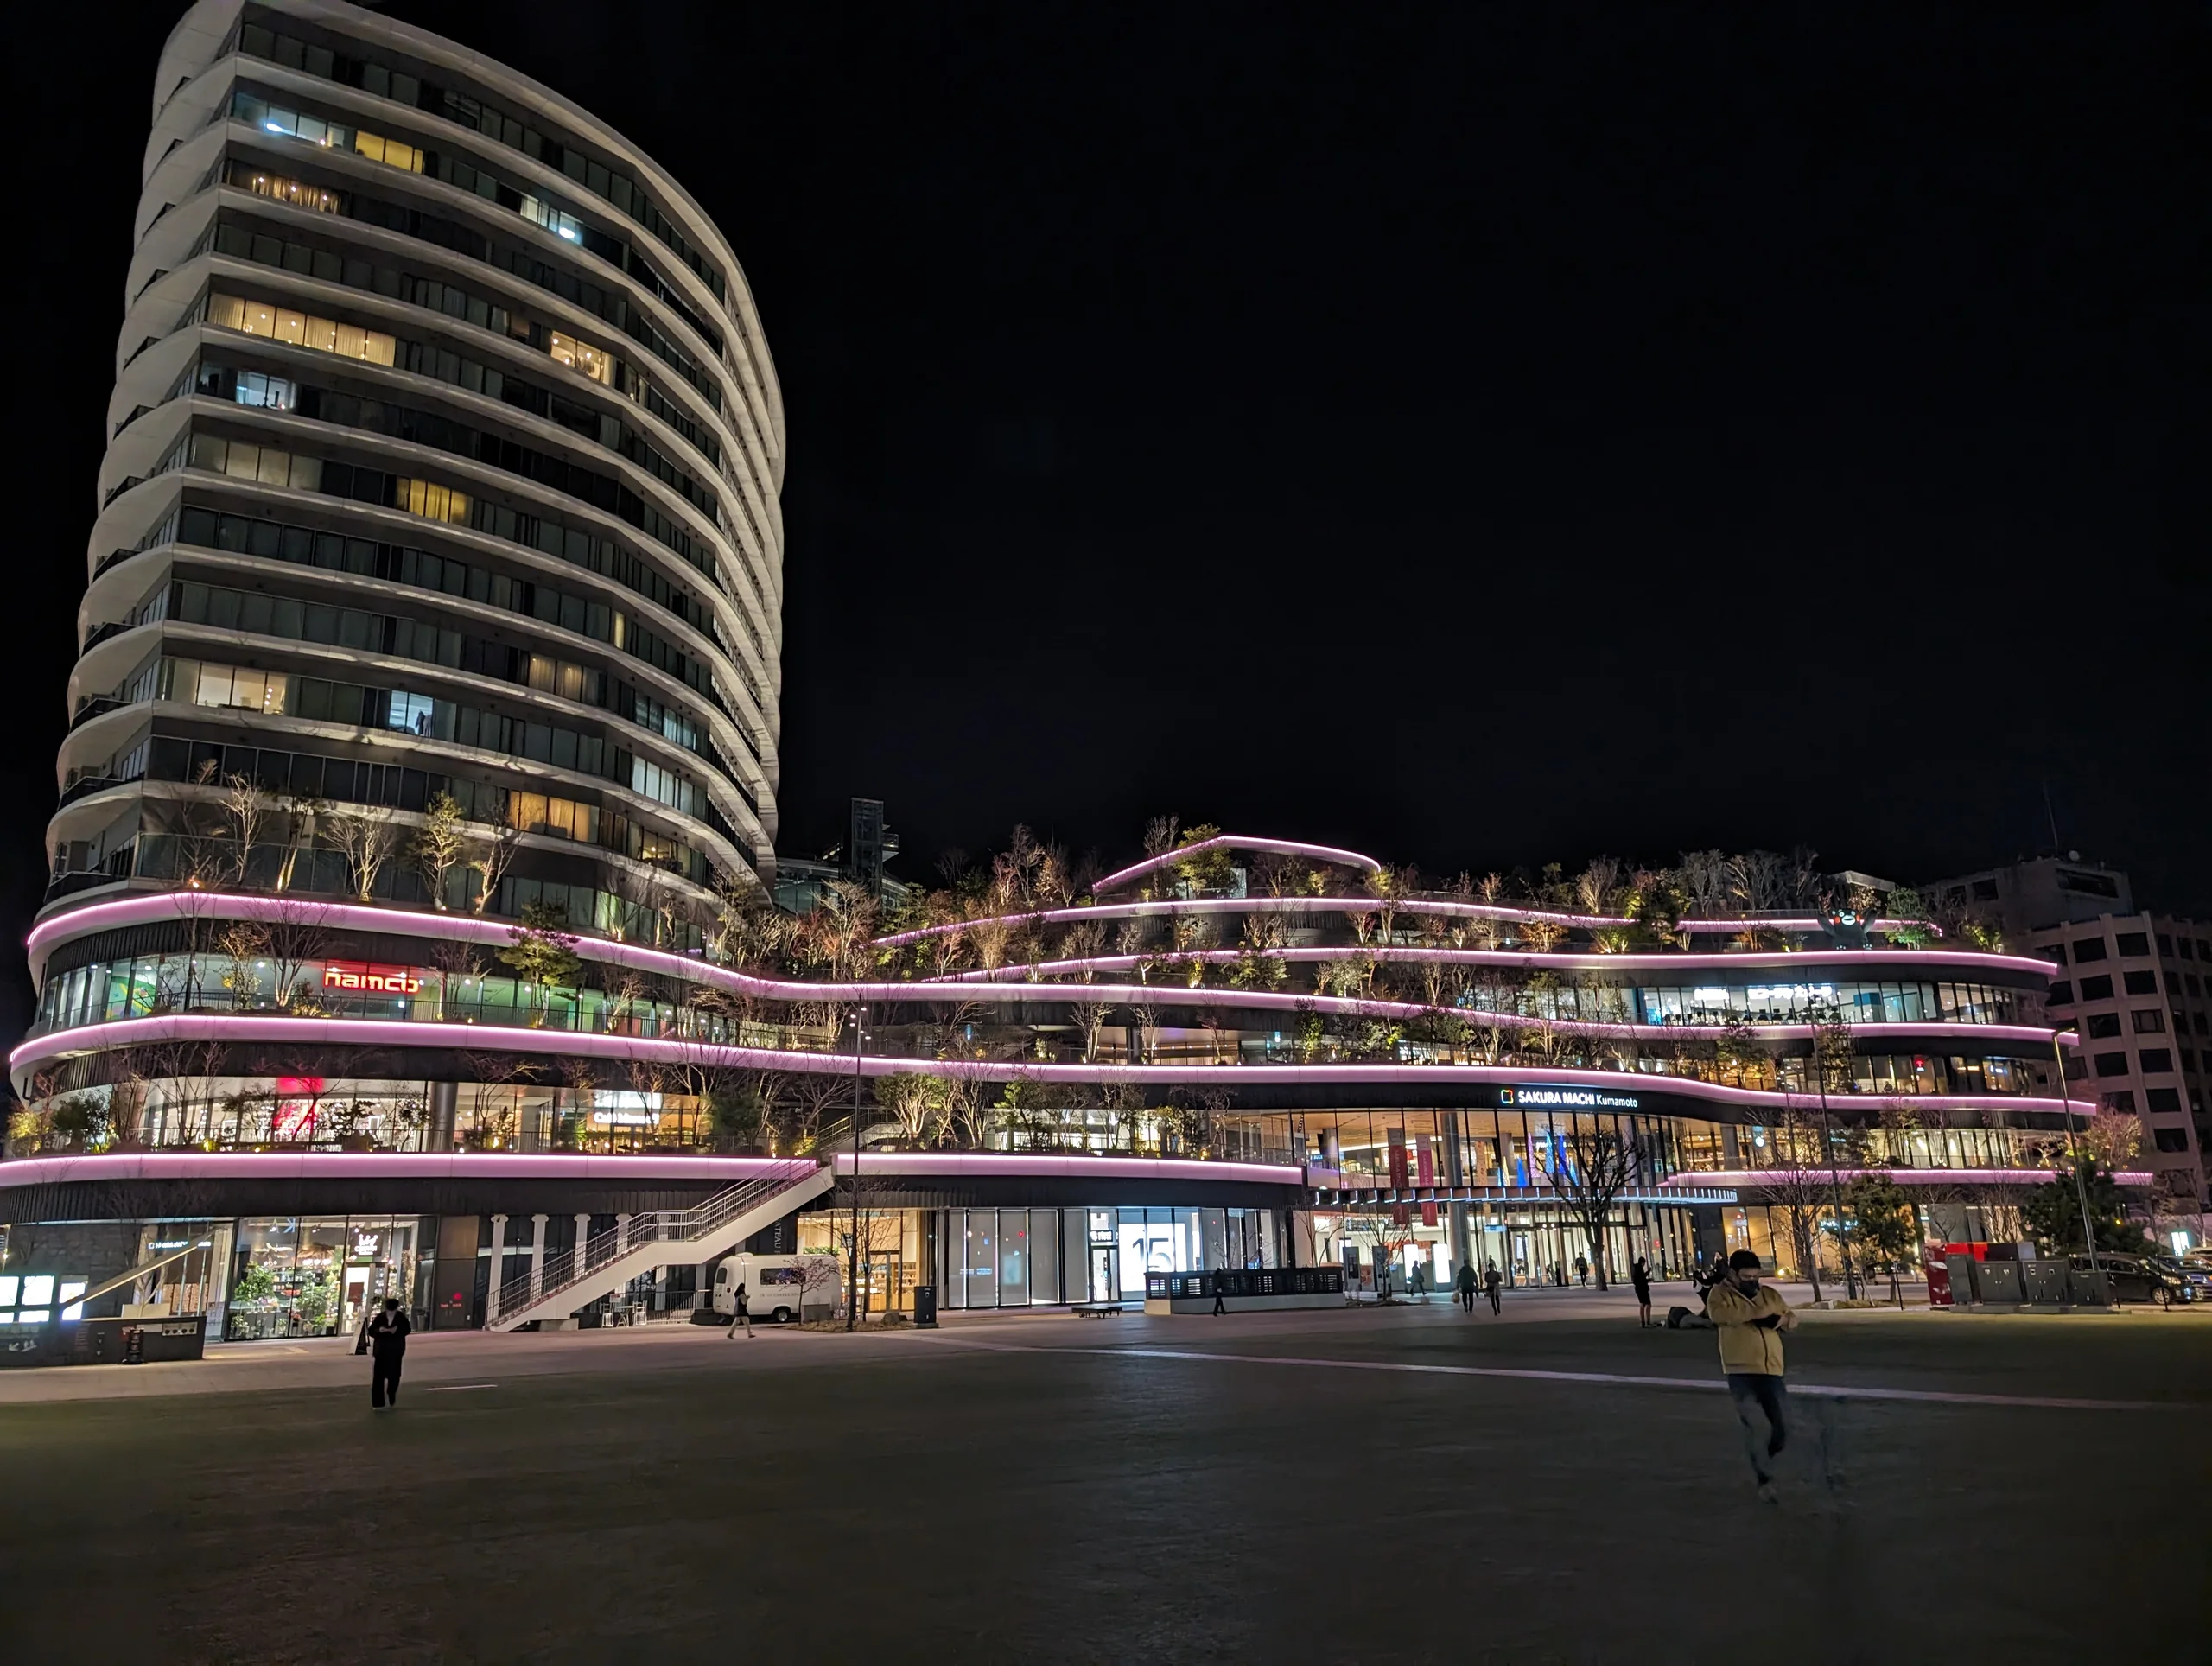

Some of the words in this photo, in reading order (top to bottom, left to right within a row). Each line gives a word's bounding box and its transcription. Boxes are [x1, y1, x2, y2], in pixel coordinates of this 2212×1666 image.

[324, 972, 419, 993] namco
[1518, 1090, 1561, 1104] SAKURA
[1562, 1091, 1596, 1106] MACHI
[1597, 1094, 1638, 1109] Kumamoto
[1132, 1237, 1172, 1269] 15
